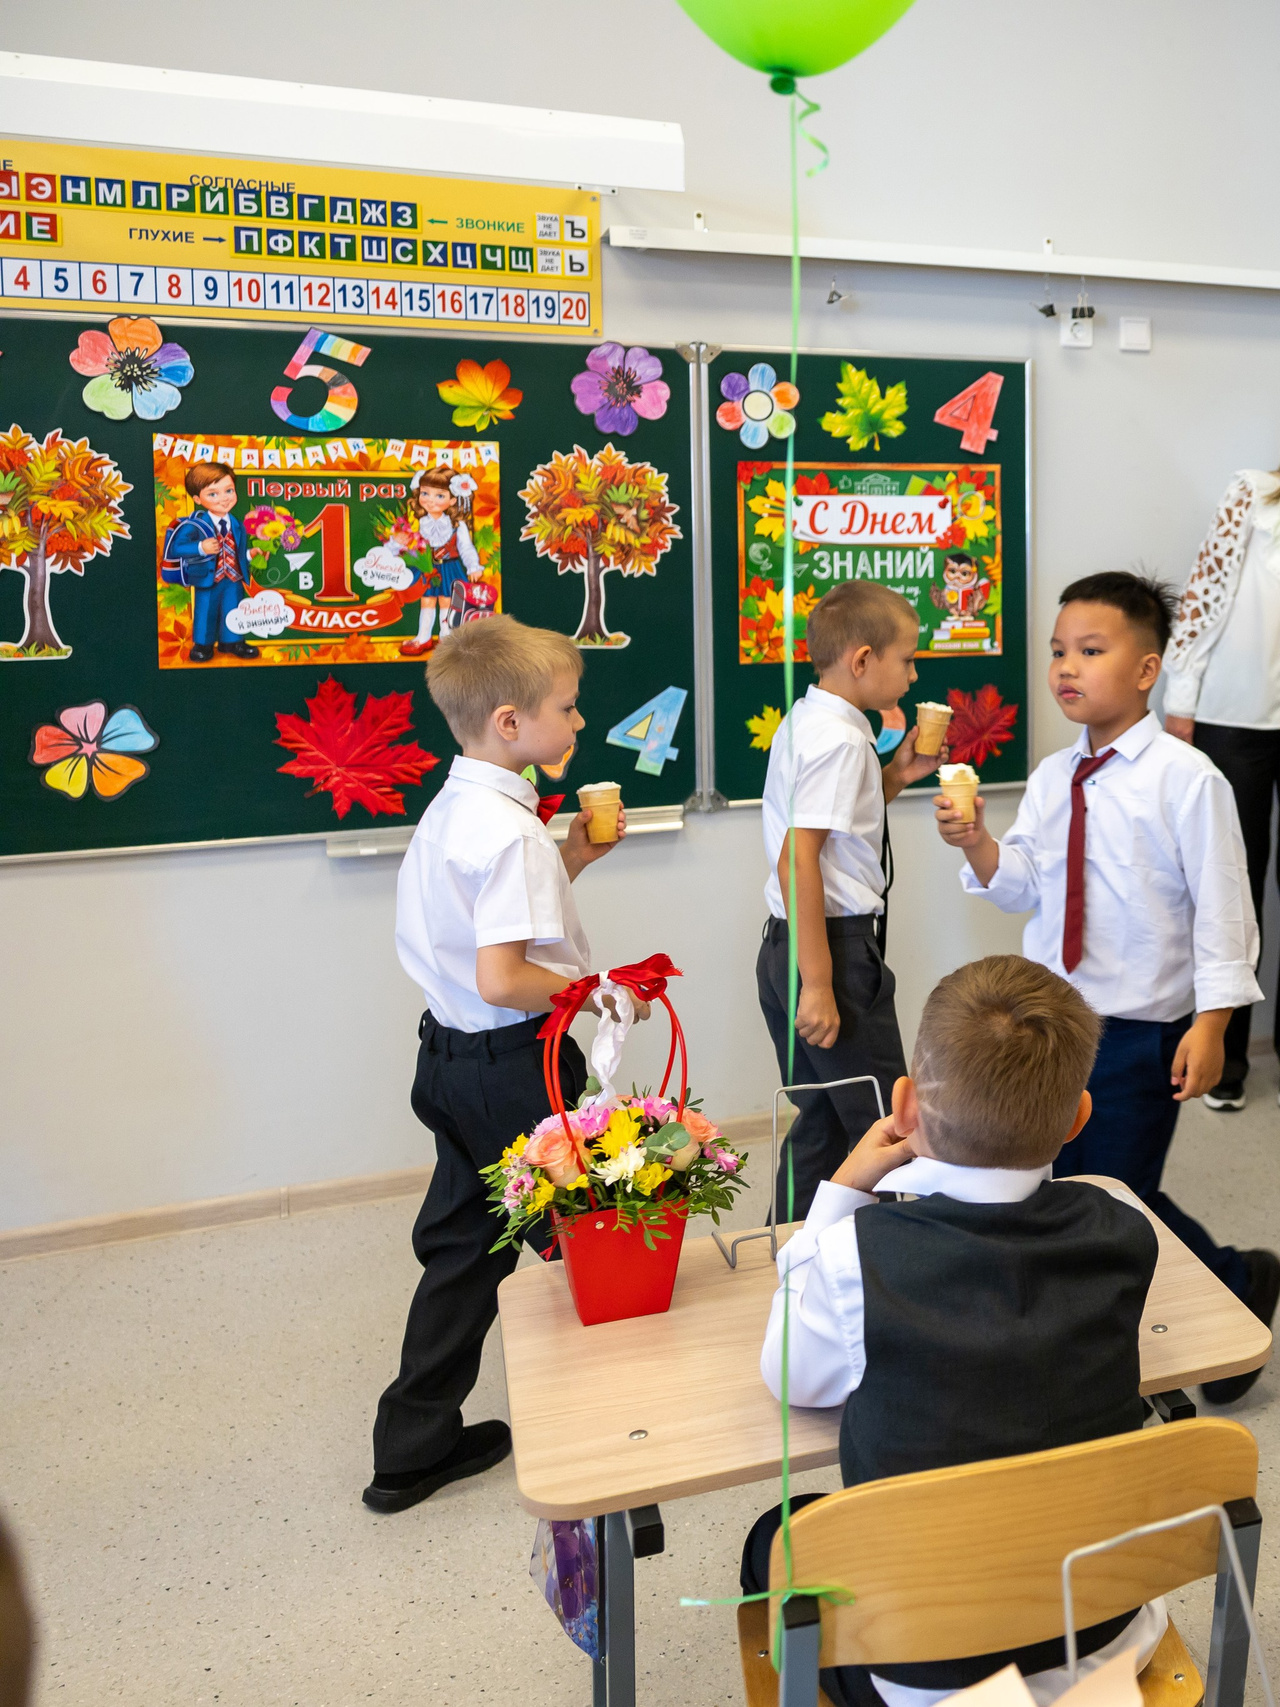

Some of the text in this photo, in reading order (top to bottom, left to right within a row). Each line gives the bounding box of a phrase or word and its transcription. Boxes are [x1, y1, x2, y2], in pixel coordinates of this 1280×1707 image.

[189, 174, 296, 194] СОГЛАСНЫЕ
[455, 217, 525, 234] ЗВОНКИЕ
[537, 214, 558, 222] ЗВУКА
[129, 228, 195, 244] ГЛУХИЕ
[538, 230, 557, 238] ДАЕТ
[565, 220, 586, 238] Ъ
[539, 249, 561, 257] ЗВУКА
[568, 254, 585, 272] Ь
[13, 265, 587, 321] 4 5 6 7 8 9 10 11 12 13 14 15 16 17 18 19 20
[271, 327, 372, 432] 5
[933, 371, 1004, 455] 4
[247, 478, 407, 501] Первый раз
[808, 500, 937, 536] С Днем
[303, 503, 360, 601] 1
[813, 546, 935, 580] ЗНАНИЙ
[299, 609, 380, 629] КЛАСС
[606, 685, 679, 776] 4
